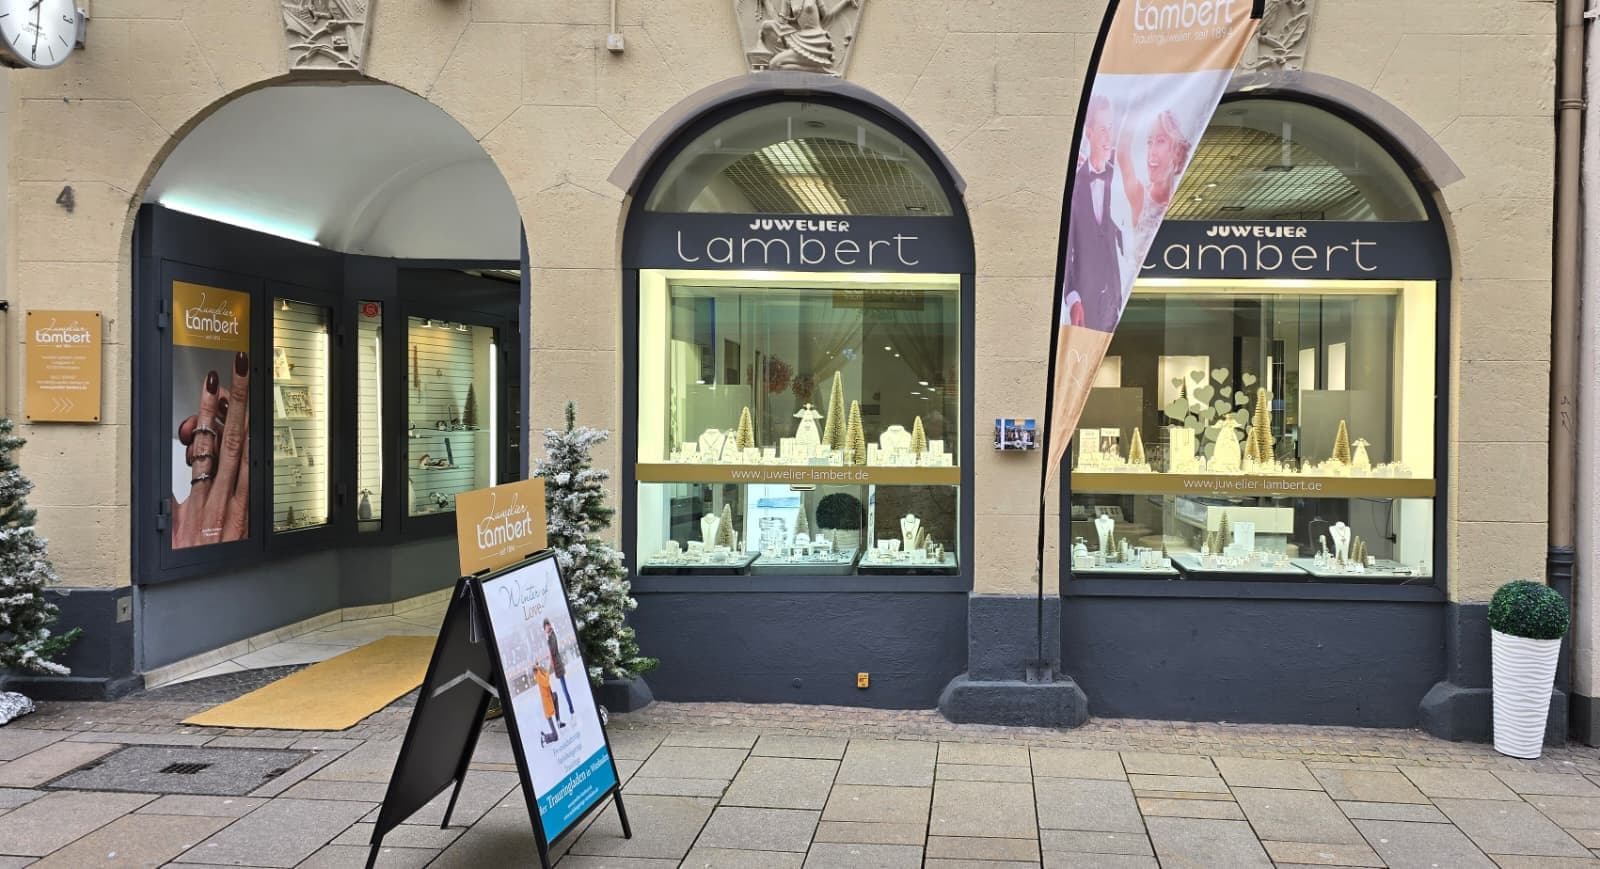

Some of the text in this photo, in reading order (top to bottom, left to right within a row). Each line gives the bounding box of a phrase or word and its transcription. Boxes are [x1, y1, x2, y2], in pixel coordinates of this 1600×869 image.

[55, 185, 75, 213] 4
[750, 218, 849, 232] JUWELIER
[1206, 225, 1308, 238] JUWELIER
[1141, 239, 1377, 271] ambert
[1183, 479, 1322, 491] www.juwelier-lambert.de
